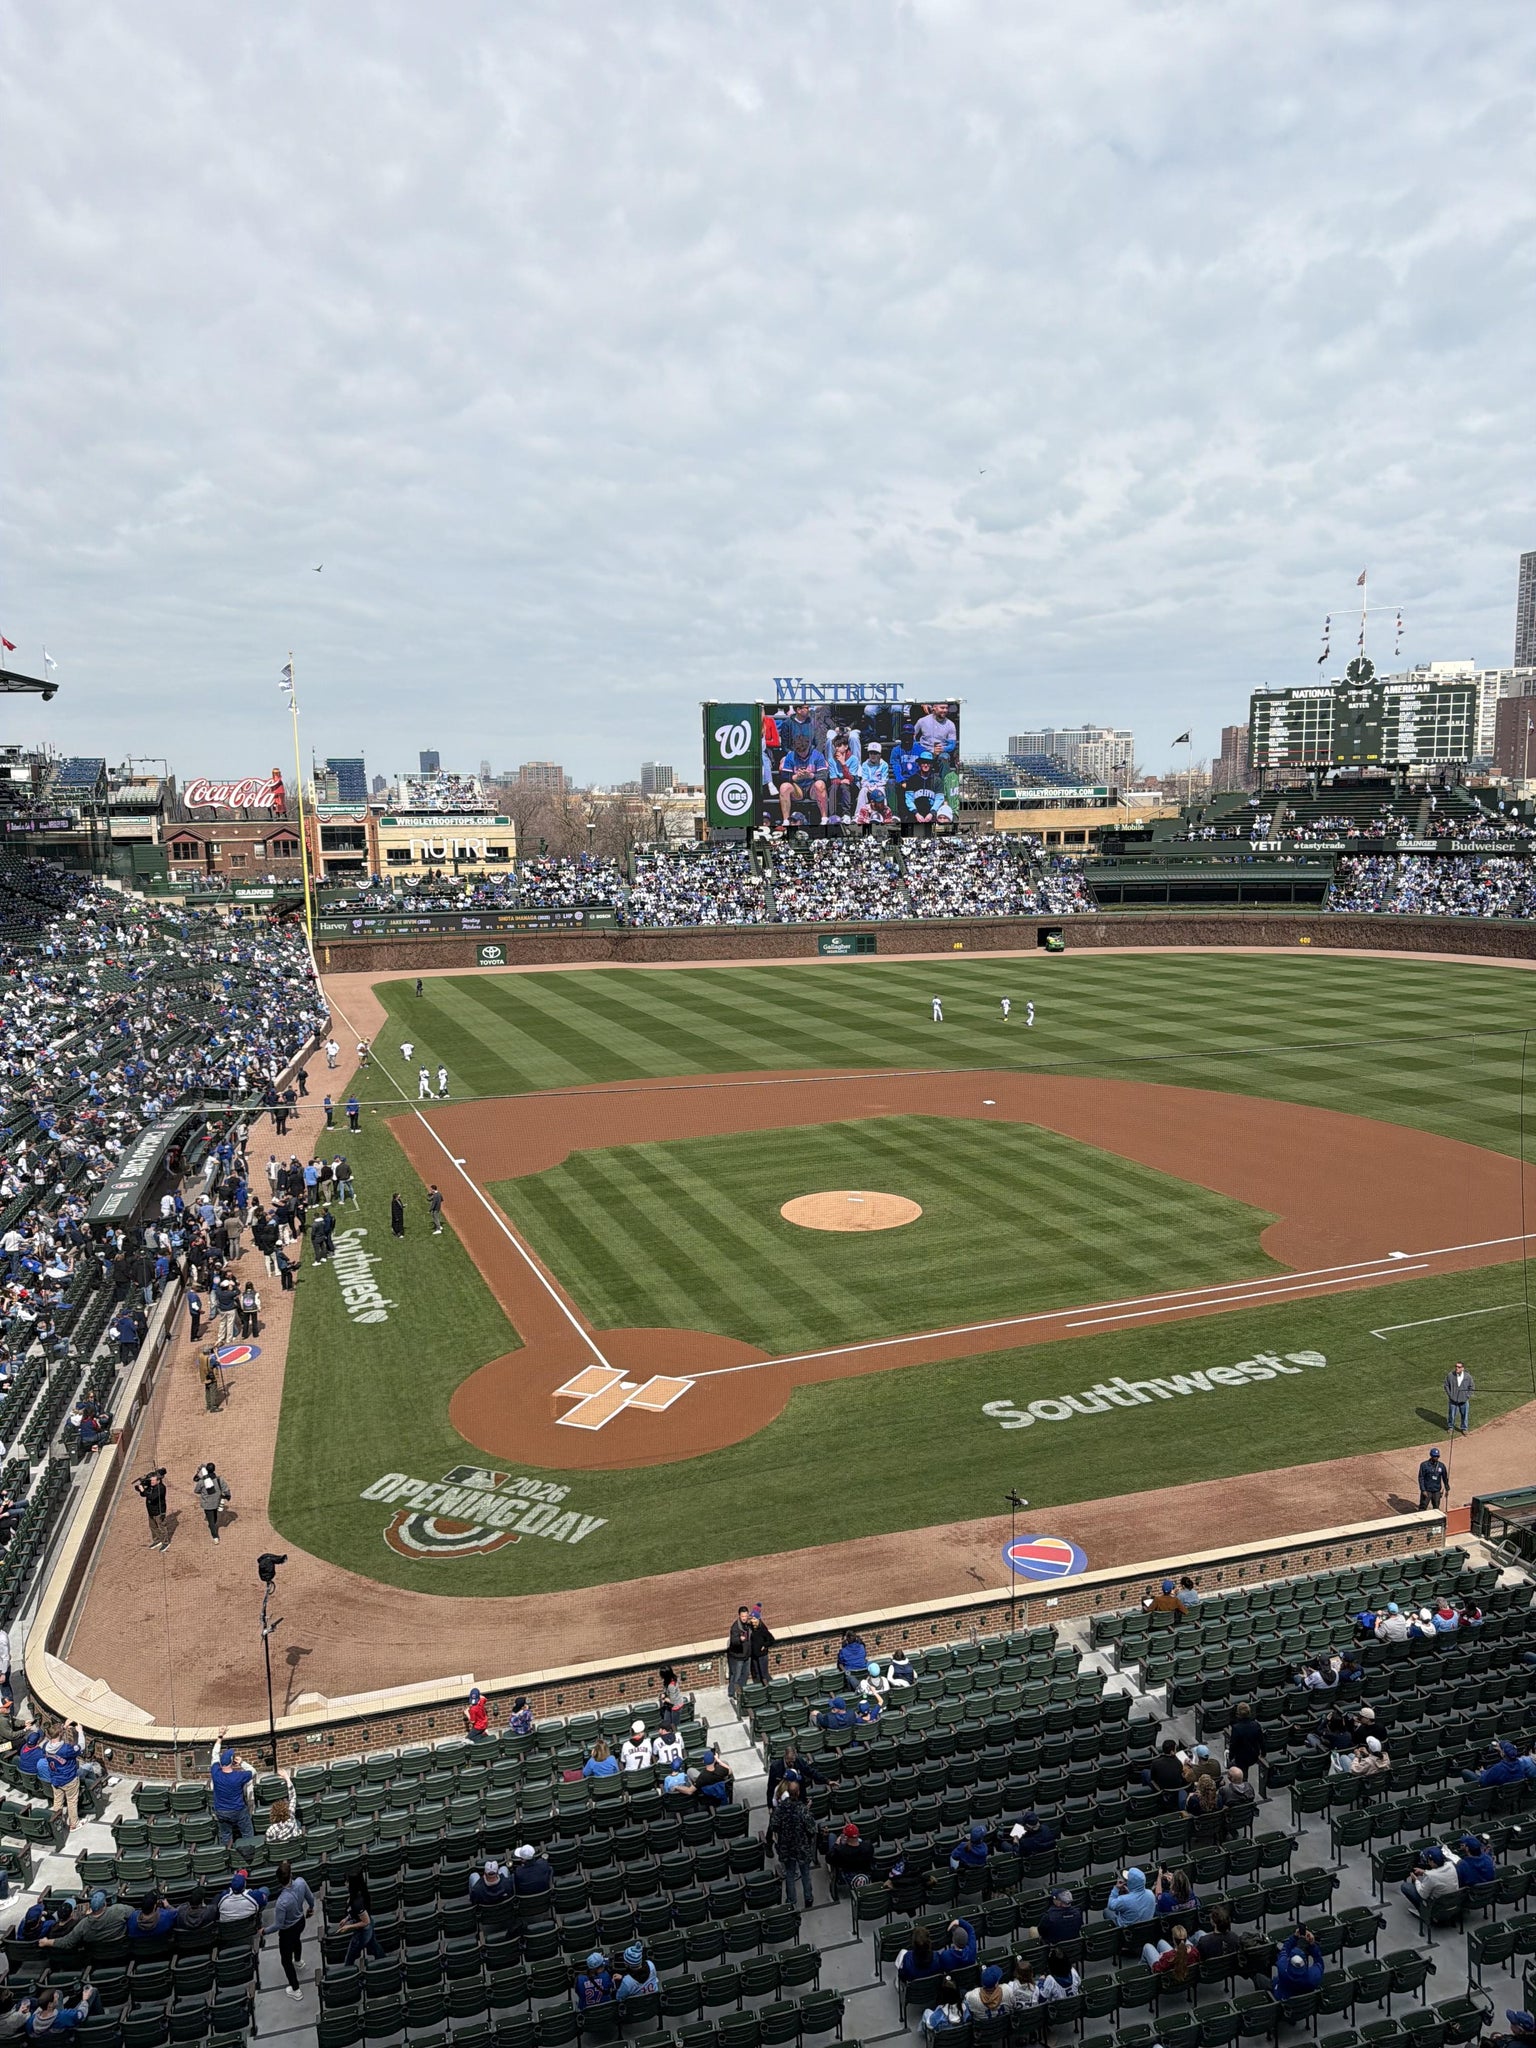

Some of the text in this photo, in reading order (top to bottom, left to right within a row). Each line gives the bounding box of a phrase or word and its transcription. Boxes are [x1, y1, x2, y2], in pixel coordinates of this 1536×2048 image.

[773, 678, 904, 701] WINTRUST
[1292, 688, 1336, 699] NATIONAL
[1383, 684, 1430, 694] AMERICAN
[184, 778, 281, 808] Coca-Cola
[1015, 788, 1094, 797] WRIGLEYROOFTOPS.COM
[396, 817, 495, 826] WRIGLEYROOFTOPS.COM
[1249, 841, 1281, 851] YETI
[1300, 842, 1346, 850] tastytrade
[320, 922, 348, 930] Harvey
[327, 1228, 392, 1314] Southwest
[982, 1352, 1303, 1429] Southwest
[501, 1476, 571, 1504] 2026
[359, 1472, 609, 1544] OPENING DAY
[635, 1756, 643, 1769] 7
